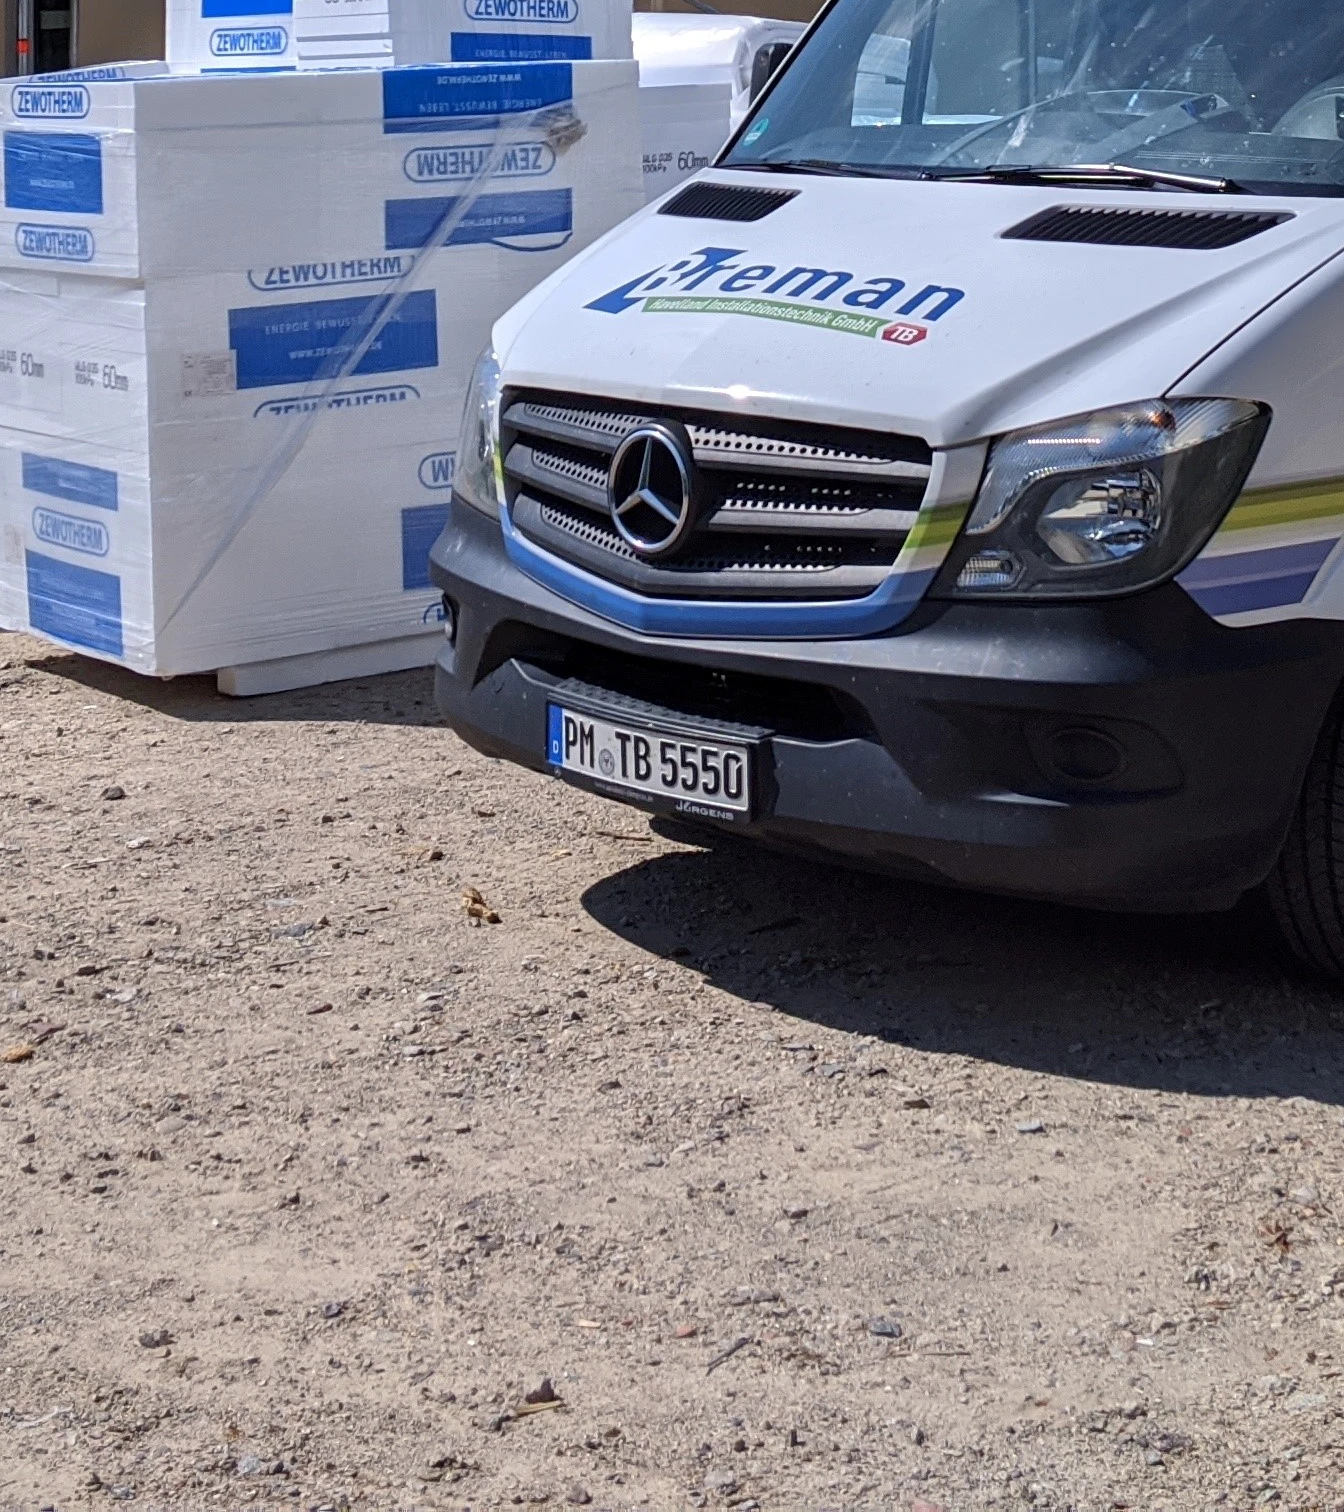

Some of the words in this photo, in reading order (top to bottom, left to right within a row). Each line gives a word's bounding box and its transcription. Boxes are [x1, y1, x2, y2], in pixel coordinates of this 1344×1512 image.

[216, 31, 282, 52] ZEWOTHERM
[17, 90, 84, 114] ZEWOTHERM
[416, 146, 543, 177] ZEWTHERM
[677, 150, 709, 172] 60mm
[21, 229, 89, 256] ZEWOTHERM
[263, 256, 403, 286] ZEWOTHERM
[624, 248, 966, 322] Breman
[650, 297, 709, 312] Havelland
[704, 297, 834, 327] Installationstechnik
[831, 312, 879, 334] GmbH
[891, 325, 918, 342] TB
[20, 352, 45, 378] 60mm
[102, 364, 129, 392] 60mm
[38, 512, 105, 552] ZEWOTHERM
[552, 740, 560, 755] D
[563, 714, 596, 770] PM
[614, 730, 652, 782] TB
[658, 739, 744, 800] 5550
